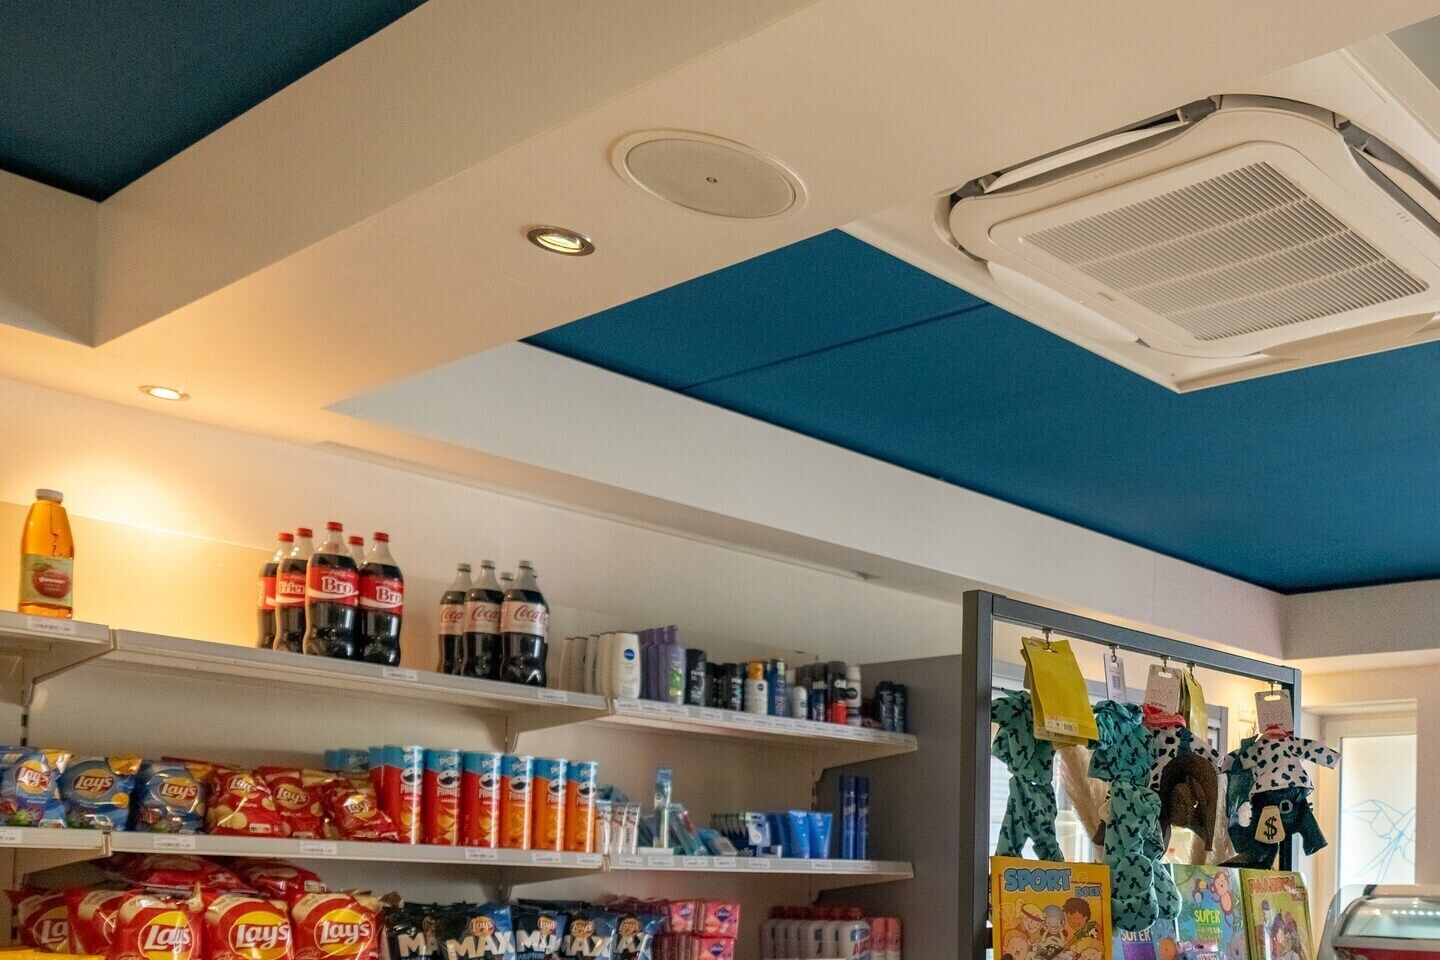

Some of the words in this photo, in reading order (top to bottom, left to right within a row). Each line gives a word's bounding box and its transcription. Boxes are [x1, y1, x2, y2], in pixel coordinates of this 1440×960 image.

[321, 576, 354, 595] Bro
[375, 585, 403, 604] Bro
[75, 775, 114, 793] Lay's
[160, 784, 198, 800] Lay's
[1004, 867, 1072, 893] SPORT
[1194, 909, 1221, 924] SUPER
[235, 922, 291, 950] Lay's
[319, 919, 371, 945] Lay's
